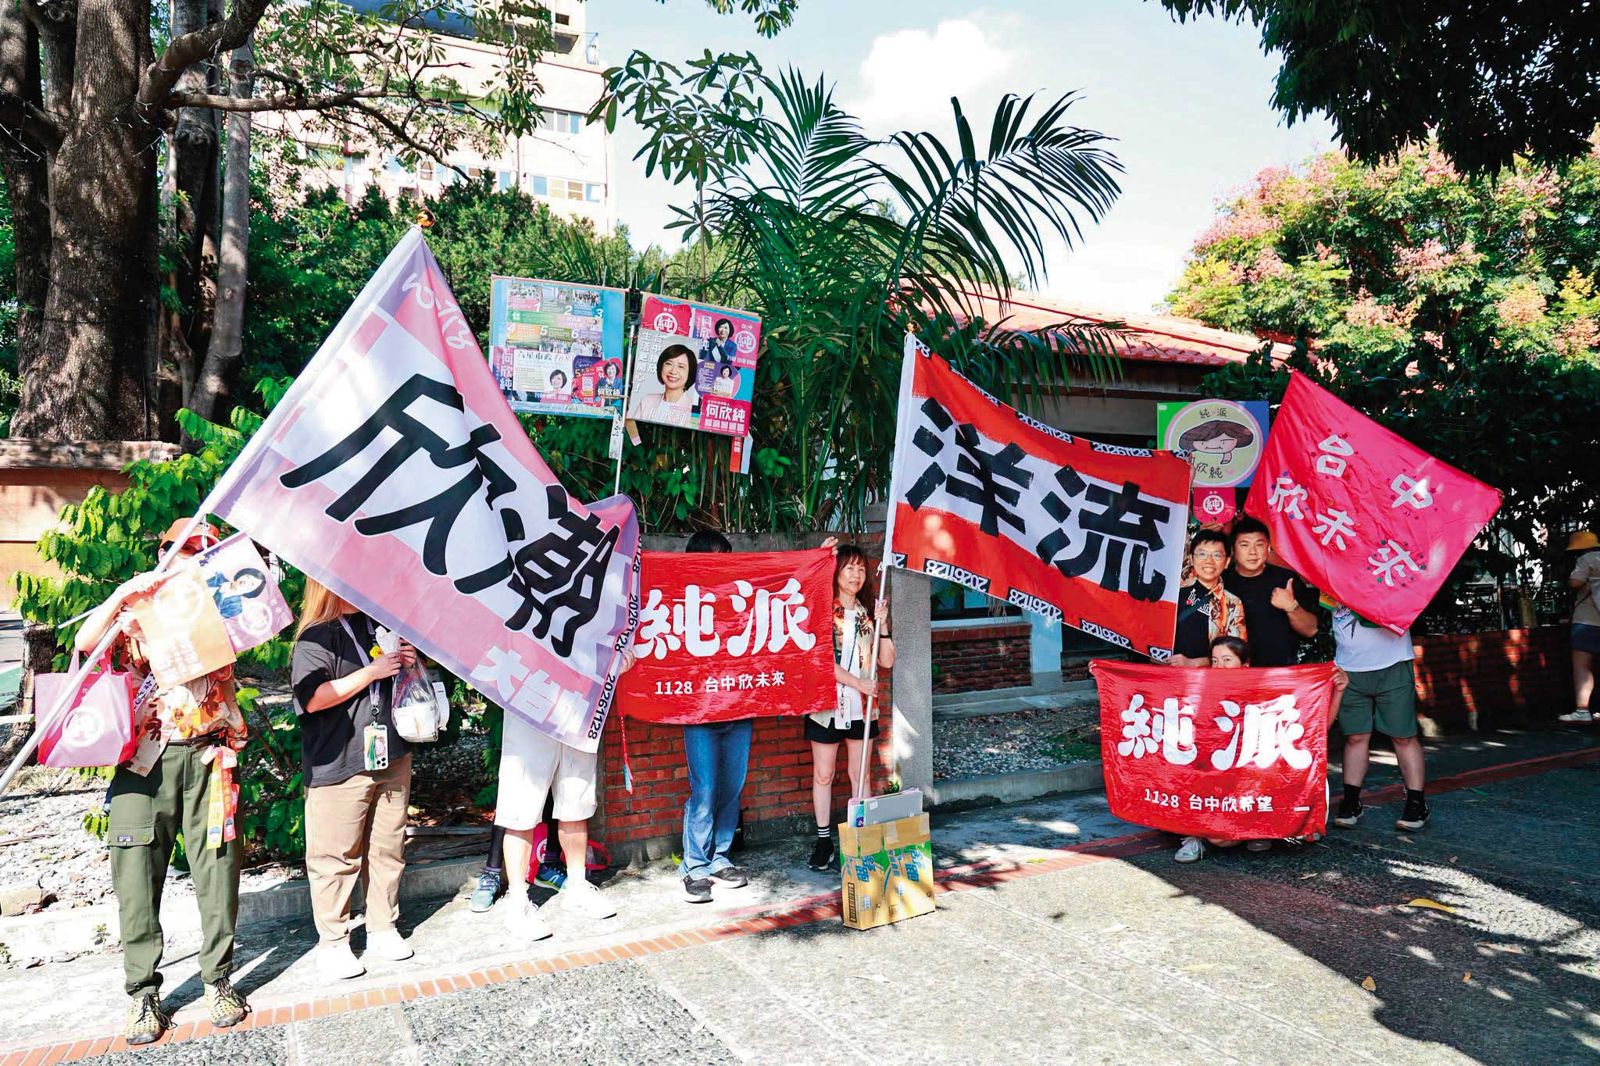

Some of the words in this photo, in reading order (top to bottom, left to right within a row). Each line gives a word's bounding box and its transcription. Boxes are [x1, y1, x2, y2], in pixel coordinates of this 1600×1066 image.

[564, 305, 573, 316] 2
[595, 308, 604, 319] 3
[540, 326, 548, 336] 5
[571, 328, 580, 339] 6
[706, 403, 746, 422] 何欣純
[905, 397, 1171, 604] 洋流
[279, 372, 621, 658] 欣潮
[925, 559, 989, 593] 20261128
[1008, 588, 1063, 622] 20261128
[632, 577, 817, 660] 純派
[470, 645, 590, 736] 大台中
[655, 681, 693, 695] 1128
[704, 671, 785, 693] 台中欣未來
[588, 673, 616, 740] 20261128
[1117, 694, 1313, 771] 純派
[1144, 788, 1179, 808] 1128
[1189, 794, 1274, 813] 台中欣希望
